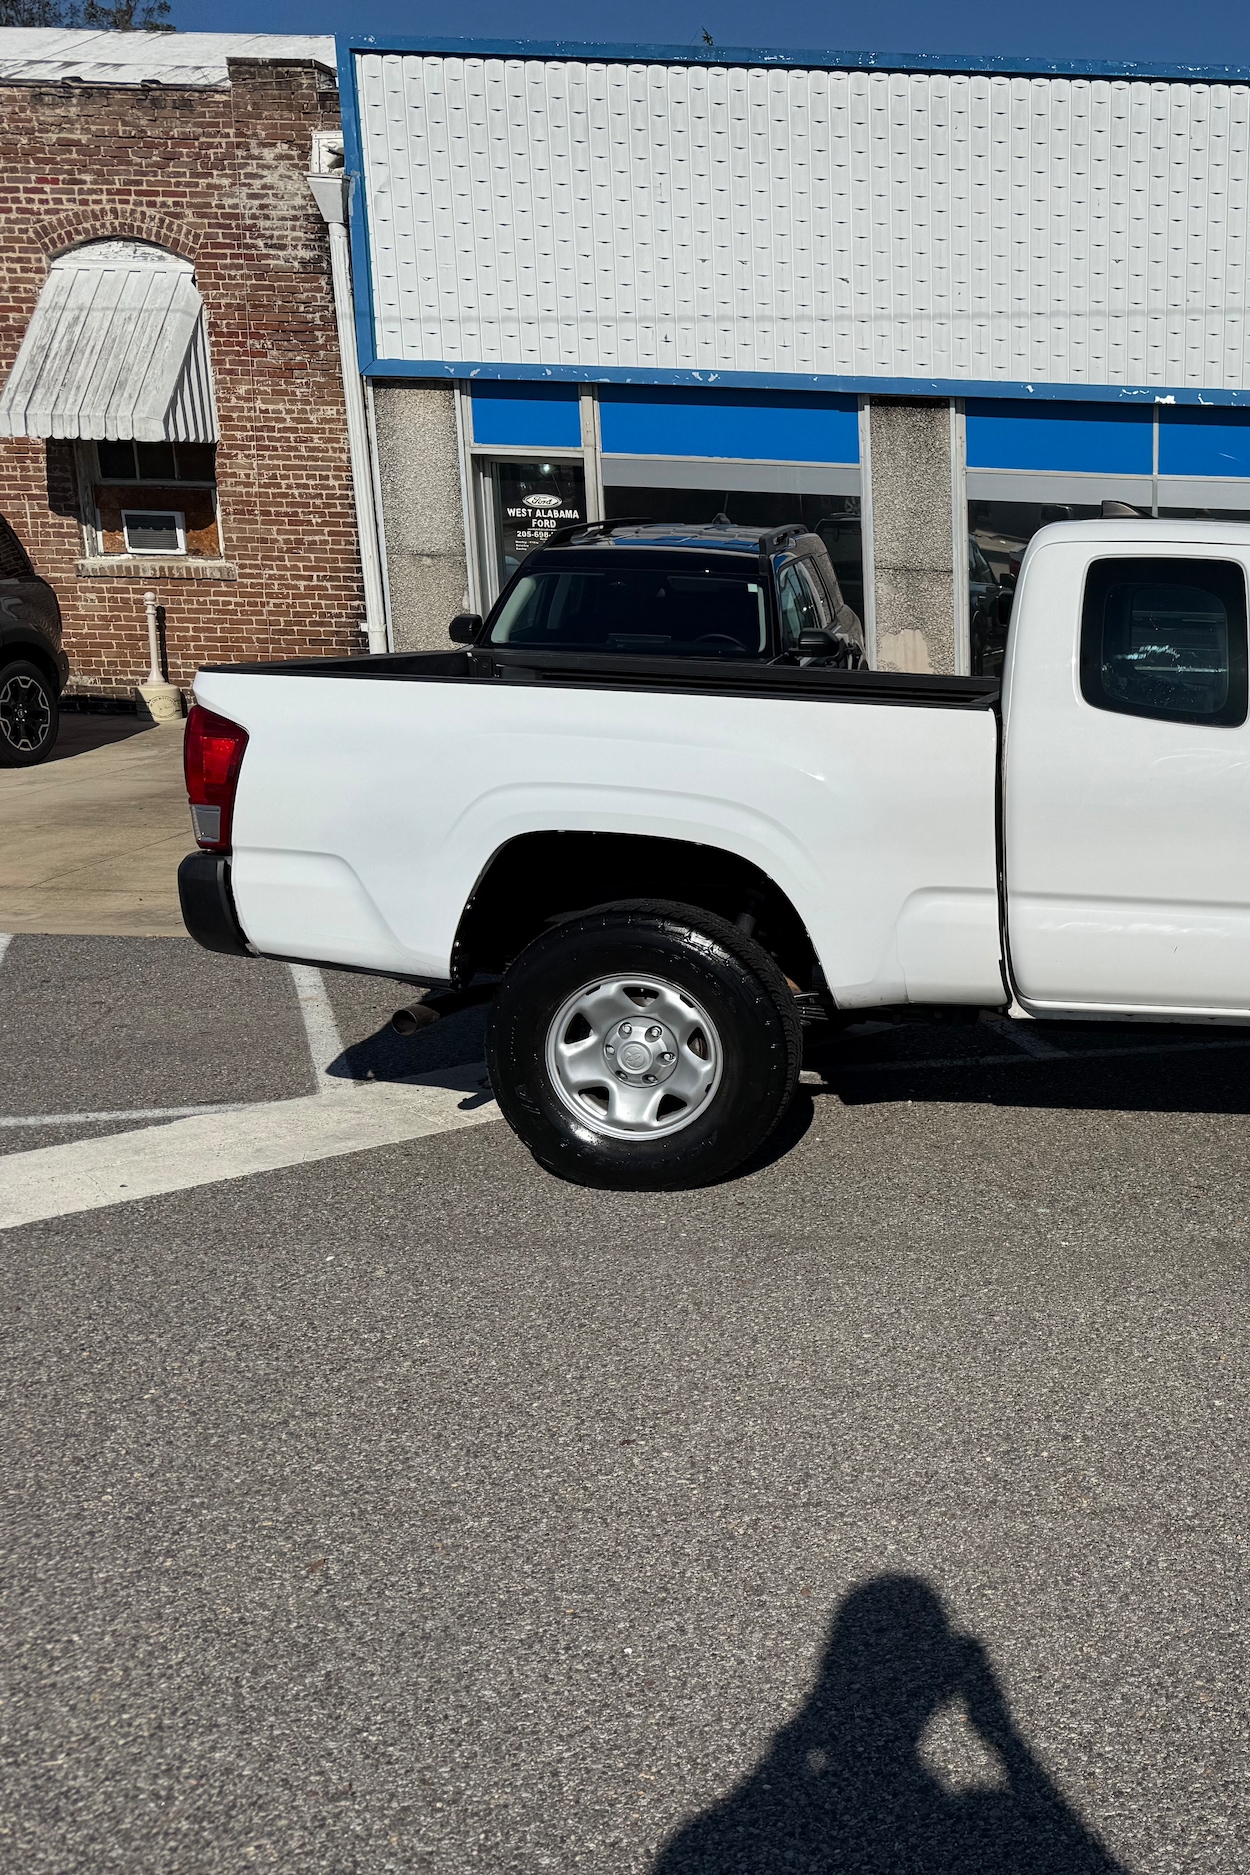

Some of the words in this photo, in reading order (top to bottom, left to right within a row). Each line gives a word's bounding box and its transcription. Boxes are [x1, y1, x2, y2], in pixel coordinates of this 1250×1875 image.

[531, 496, 552, 505] Ford
[507, 508, 532, 517] WEST
[535, 509, 579, 519] ALABAMA
[531, 519, 557, 528] FORD
[516, 530, 554, 538] 205-698-
